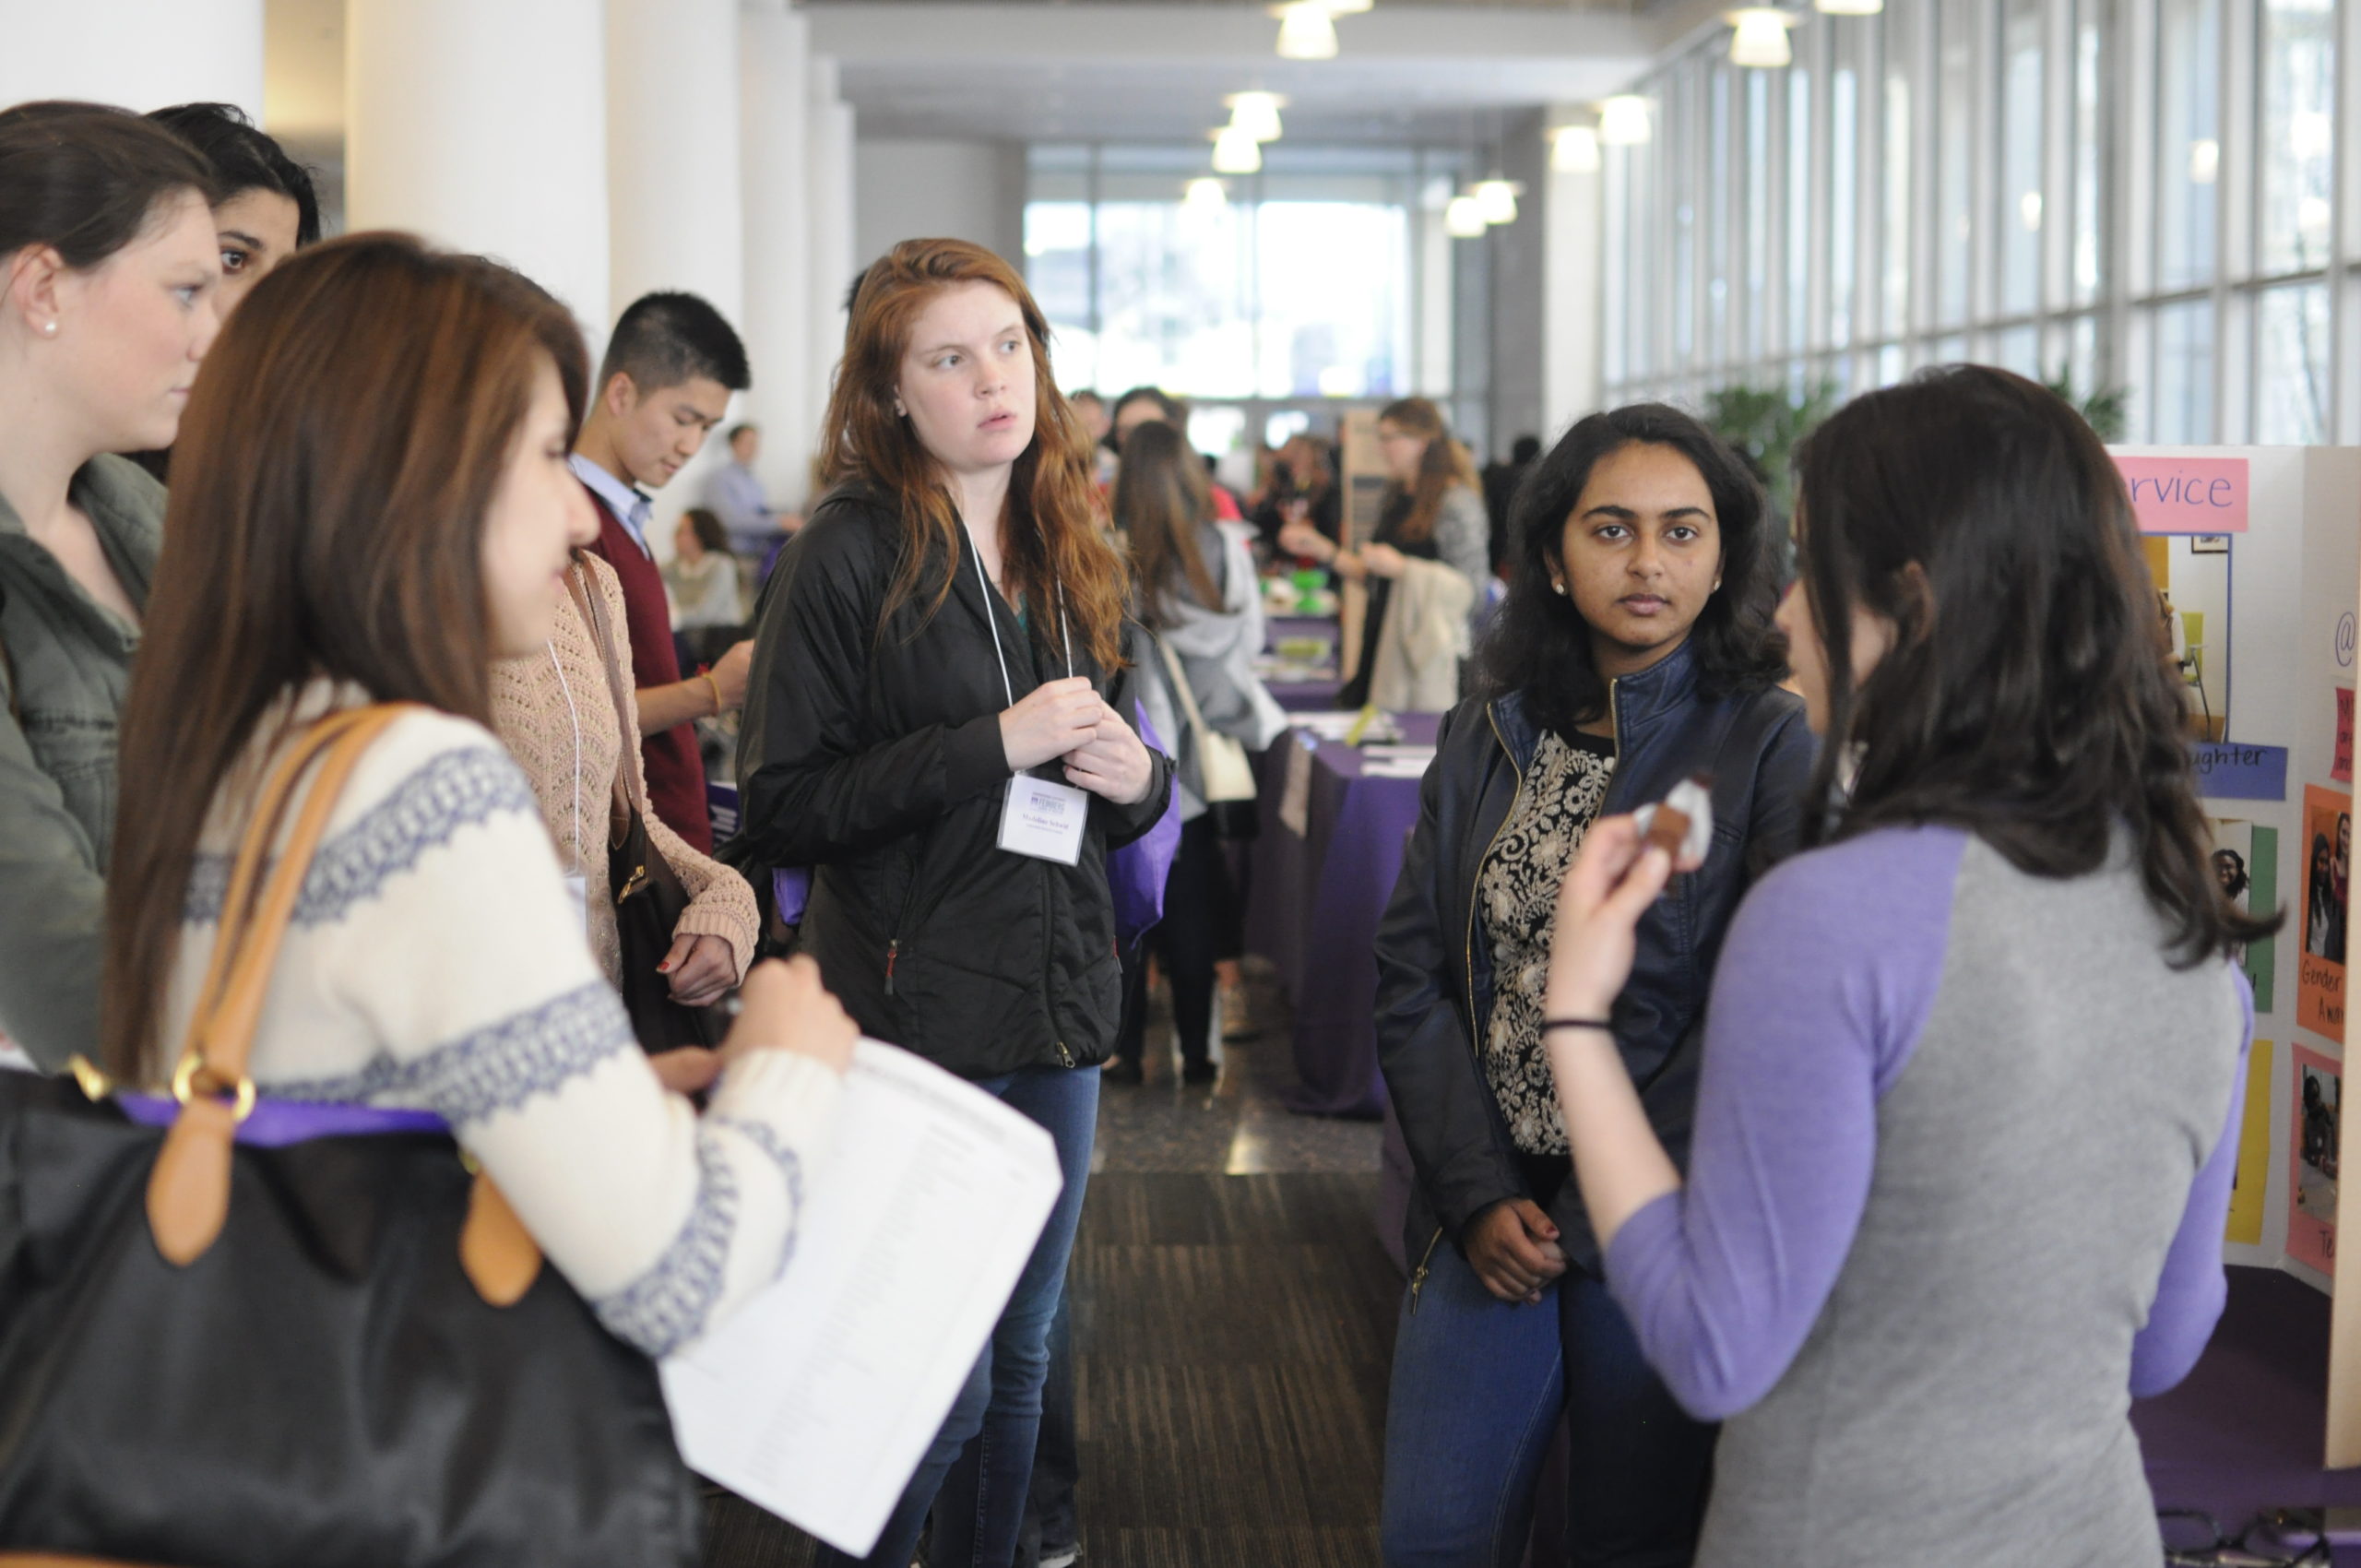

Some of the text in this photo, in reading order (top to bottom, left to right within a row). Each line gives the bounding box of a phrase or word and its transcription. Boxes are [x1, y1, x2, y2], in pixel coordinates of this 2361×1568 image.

[2131, 469, 2234, 507] rvice
[2335, 611, 2357, 667] @
[2301, 958, 2343, 992] Gender
